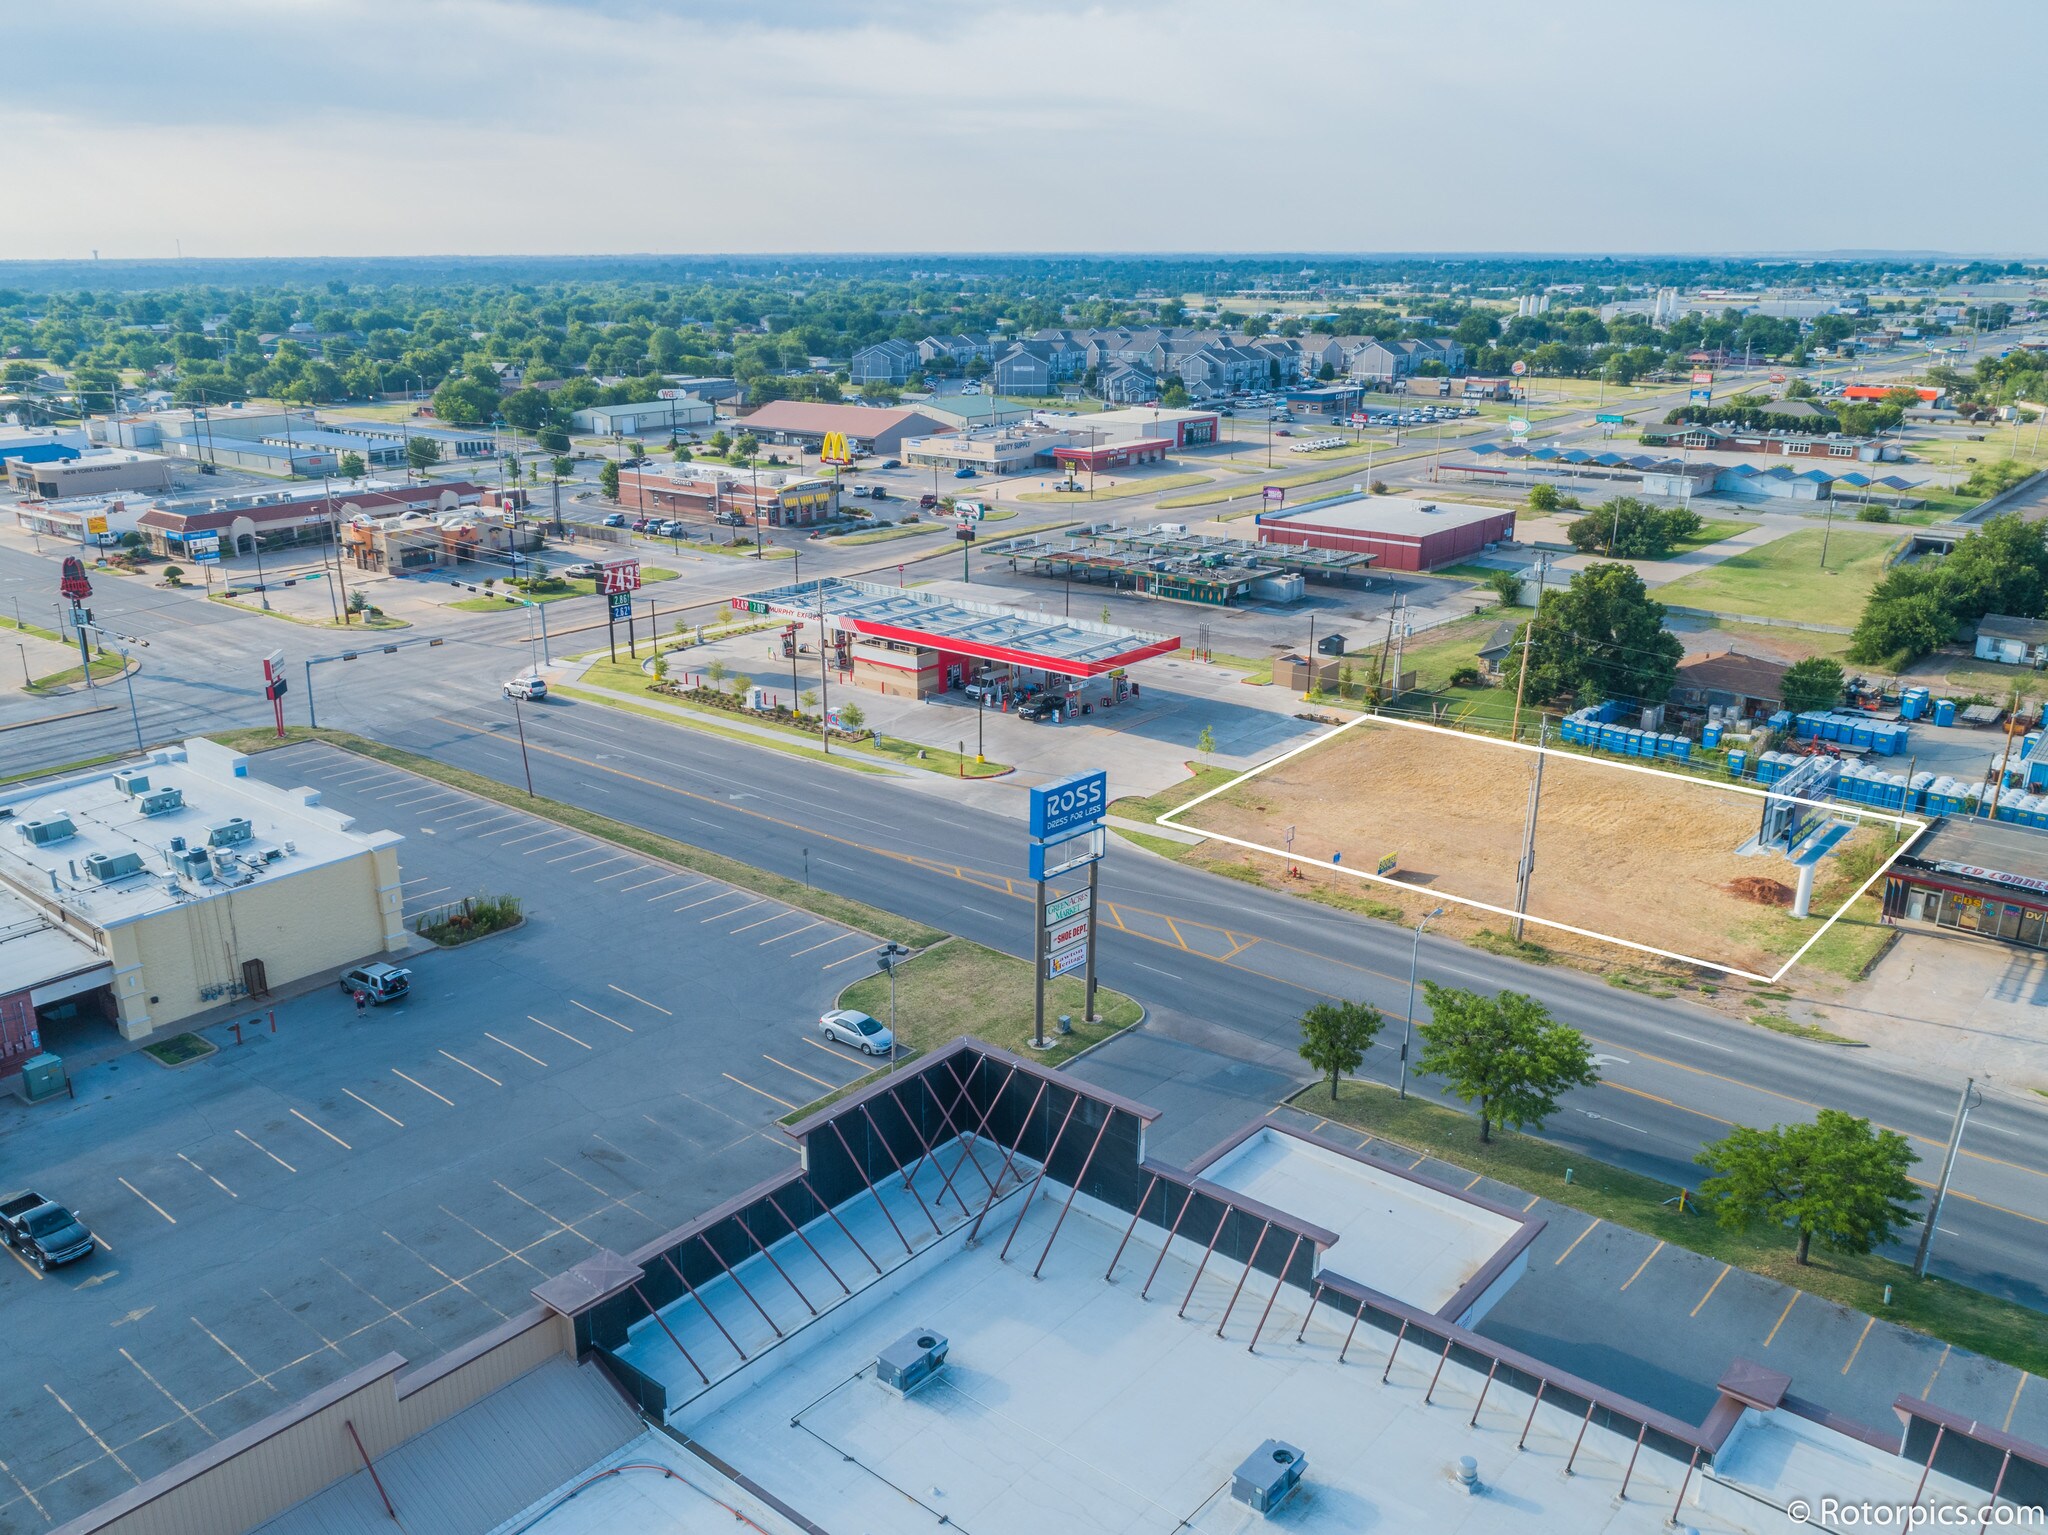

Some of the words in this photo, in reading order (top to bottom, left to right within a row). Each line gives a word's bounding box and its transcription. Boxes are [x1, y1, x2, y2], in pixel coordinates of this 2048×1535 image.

[995, 442, 1014, 452] BEAUTY
[1014, 441, 1031, 449] SUPPLY
[768, 606, 795, 617] MURPHY
[1047, 780, 1101, 818] ROSS
[1047, 815, 1068, 830] DRESS
[1070, 811, 1083, 822] FOR
[1085, 804, 1101, 816] LESS
[1961, 866, 1985, 876] CD
[1055, 904, 1080, 920] MARKET
[1057, 932, 1072, 944] SHOE
[1072, 923, 1088, 937] DEPT.
